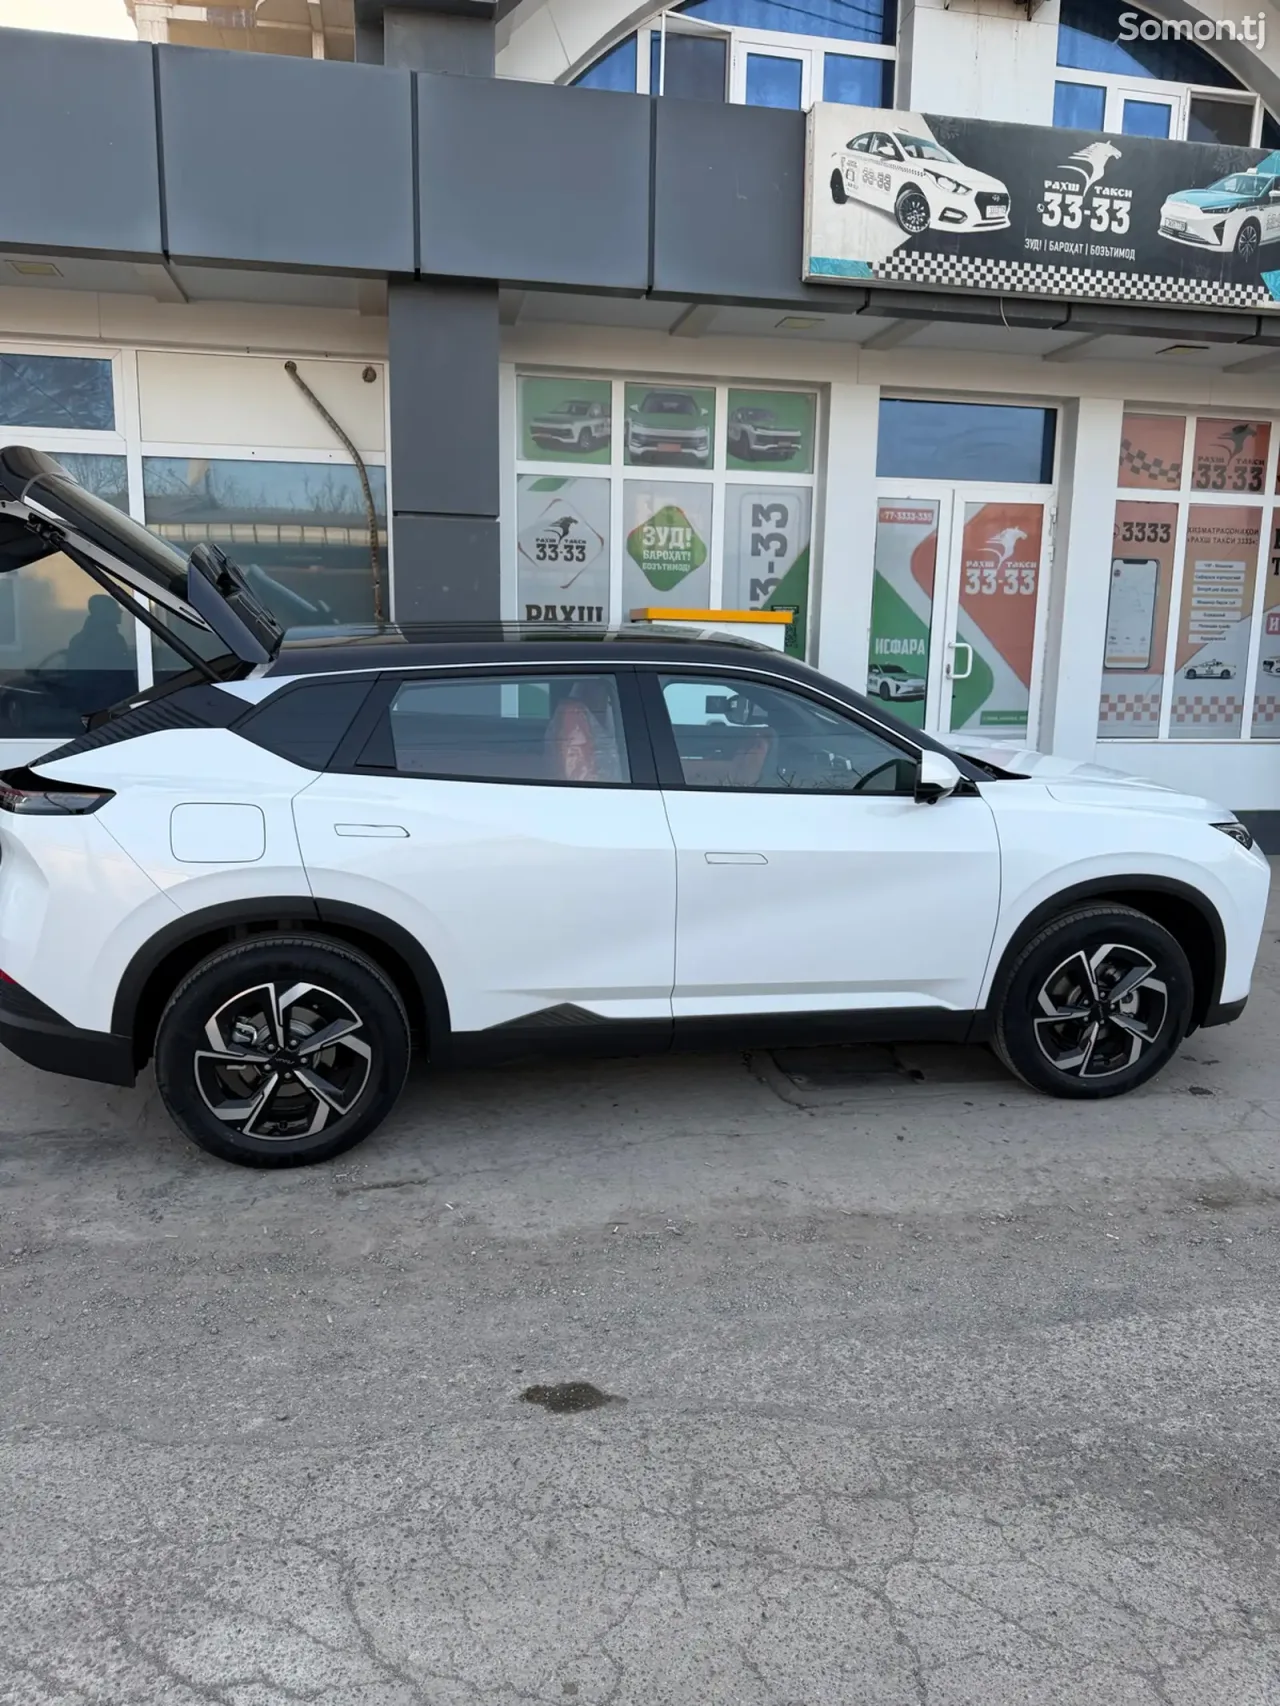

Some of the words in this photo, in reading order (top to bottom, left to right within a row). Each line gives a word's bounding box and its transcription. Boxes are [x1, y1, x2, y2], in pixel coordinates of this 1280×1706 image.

[1044, 180, 1080, 192] РАХШ
[1094, 186, 1133, 198] ТАКСИ
[1041, 191, 1131, 235] 33-33
[1196, 464, 1264, 492] 33-33
[642, 526, 692, 549] ЗУД!
[1122, 521, 1171, 543] 3333
[536, 543, 586, 562] 33-33
[965, 569, 1035, 595] 33-33
[875, 639, 926, 655] ИСФАРА
